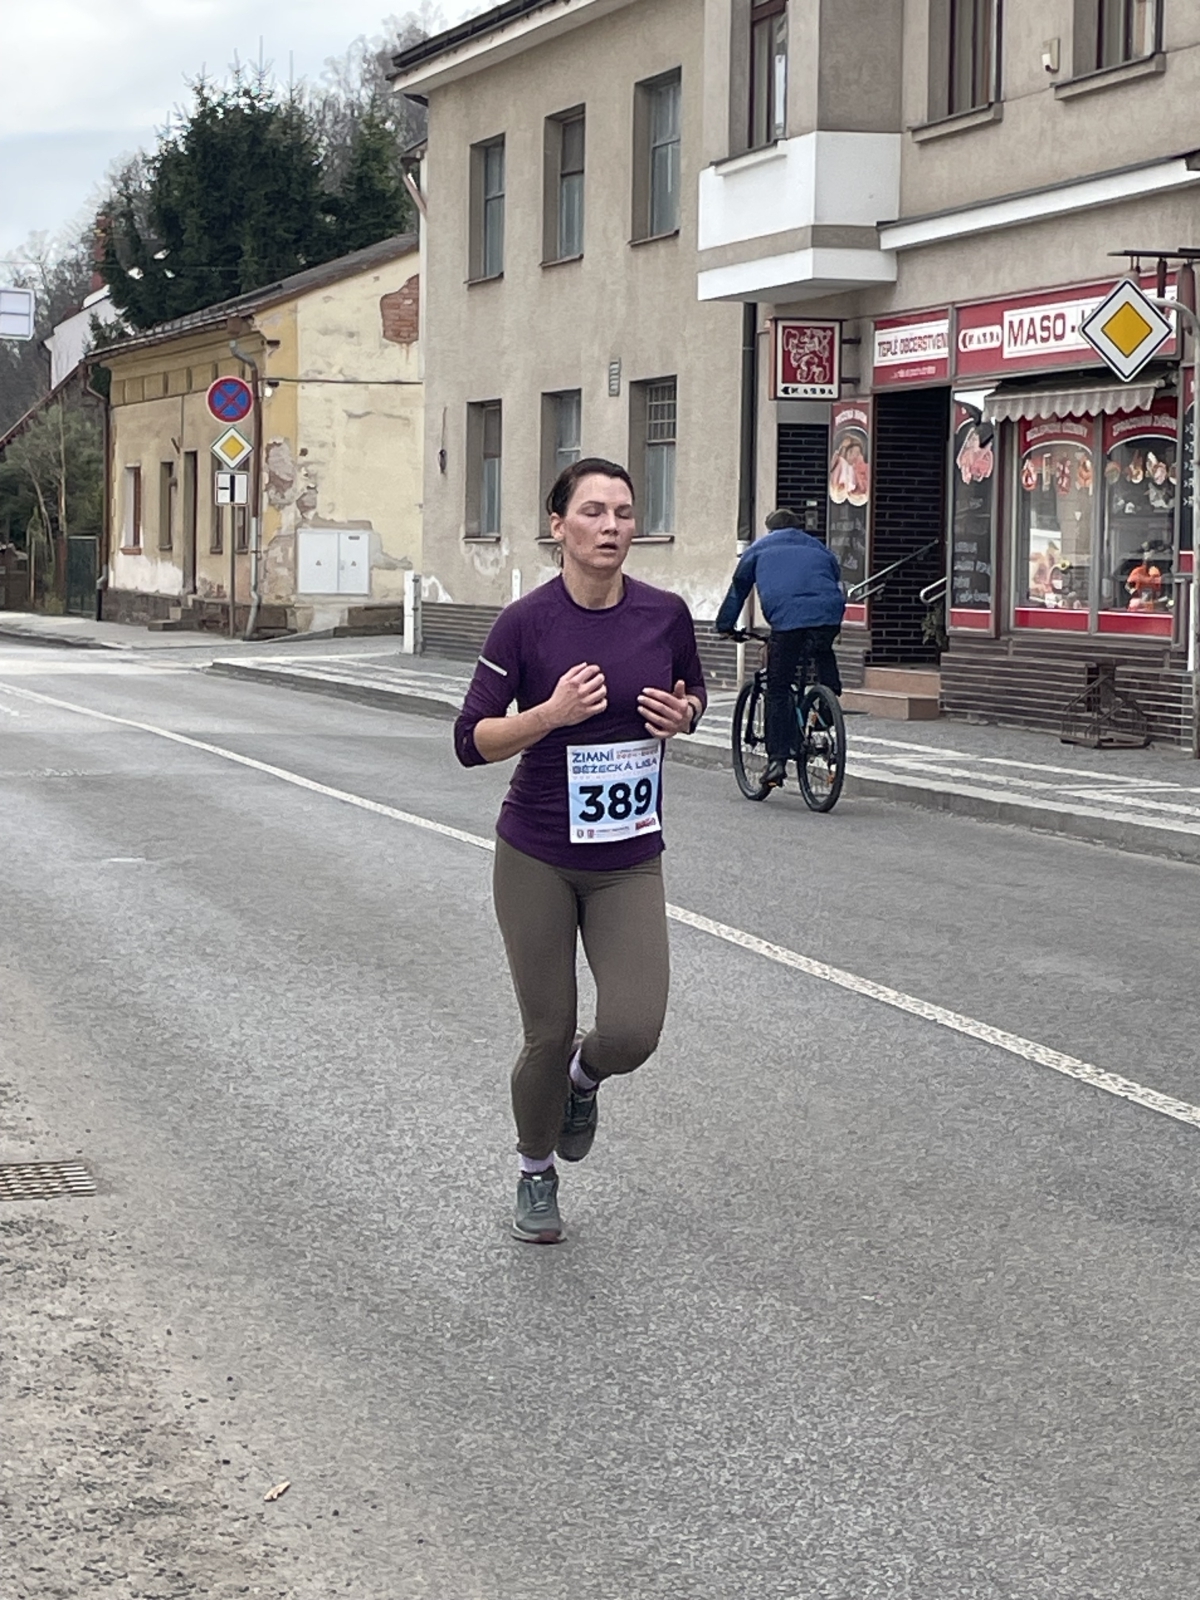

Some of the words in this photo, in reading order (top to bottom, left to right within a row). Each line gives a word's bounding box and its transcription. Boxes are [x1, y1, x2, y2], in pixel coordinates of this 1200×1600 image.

[1008, 313, 1066, 348] MASO
[878, 336, 898, 357] TEPLÉ
[900, 332, 948, 354] OBČERSTVEN
[572, 748, 614, 762] ZIMNÍ
[635, 758, 657, 769] LIGA
[579, 777, 652, 822] 389
